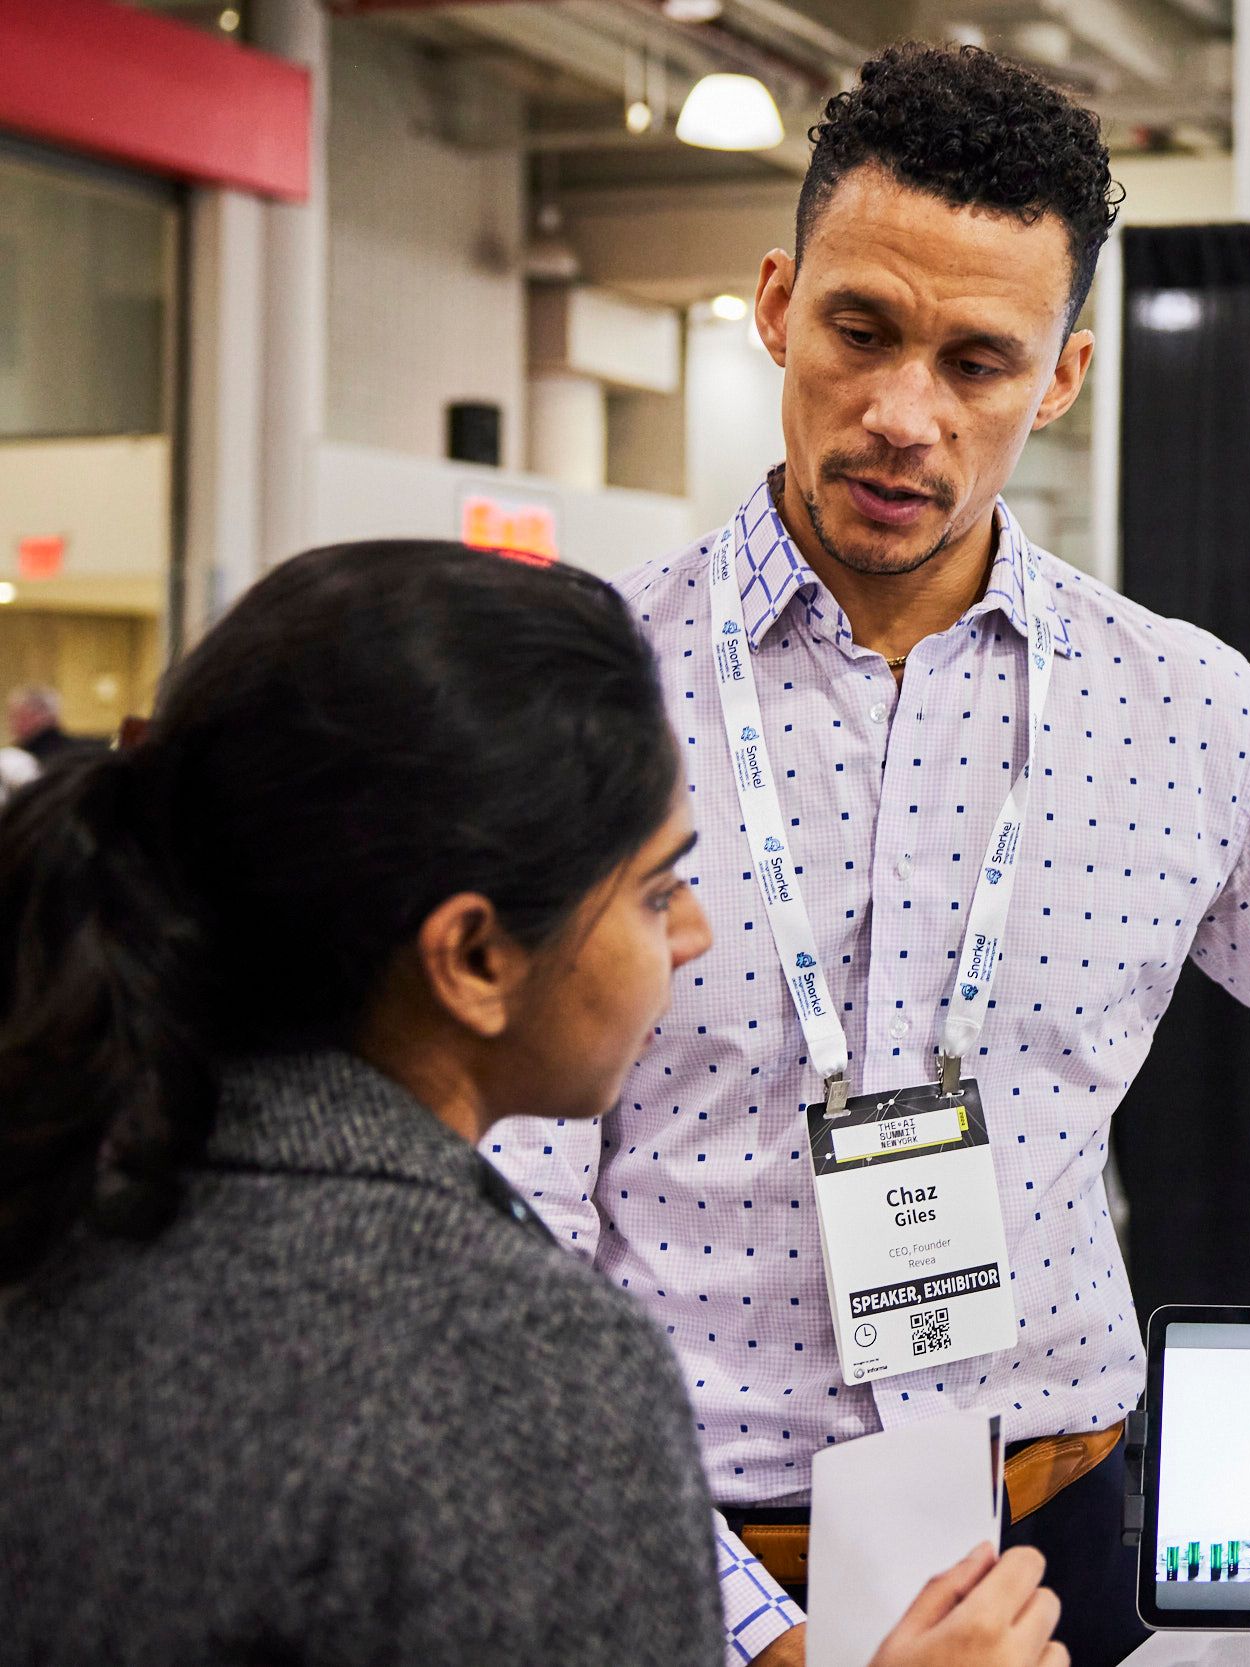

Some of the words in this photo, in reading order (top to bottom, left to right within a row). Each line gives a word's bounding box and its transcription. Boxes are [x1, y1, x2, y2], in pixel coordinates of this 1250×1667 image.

[721, 543, 730, 581] Snorkel
[728, 639, 744, 680] Snorkel
[747, 746, 765, 788] Snorkel
[992, 822, 1012, 863] Snorkel
[771, 858, 792, 902] Snorkel
[968, 934, 986, 978] Snorkel
[804, 973, 826, 1016] Snorkel
[880, 1127, 916, 1141] SUMMIT
[881, 1139, 898, 1148] NEW
[898, 1136, 918, 1145] YORK
[886, 1185, 938, 1207] Chaz
[895, 1208, 936, 1227] Giles
[888, 1246, 911, 1258] CEO,
[913, 1238, 951, 1253] Founder
[908, 1256, 936, 1268] Revea
[852, 1287, 922, 1314] SPEAKER,
[923, 1268, 999, 1299] EXHIBITOR
